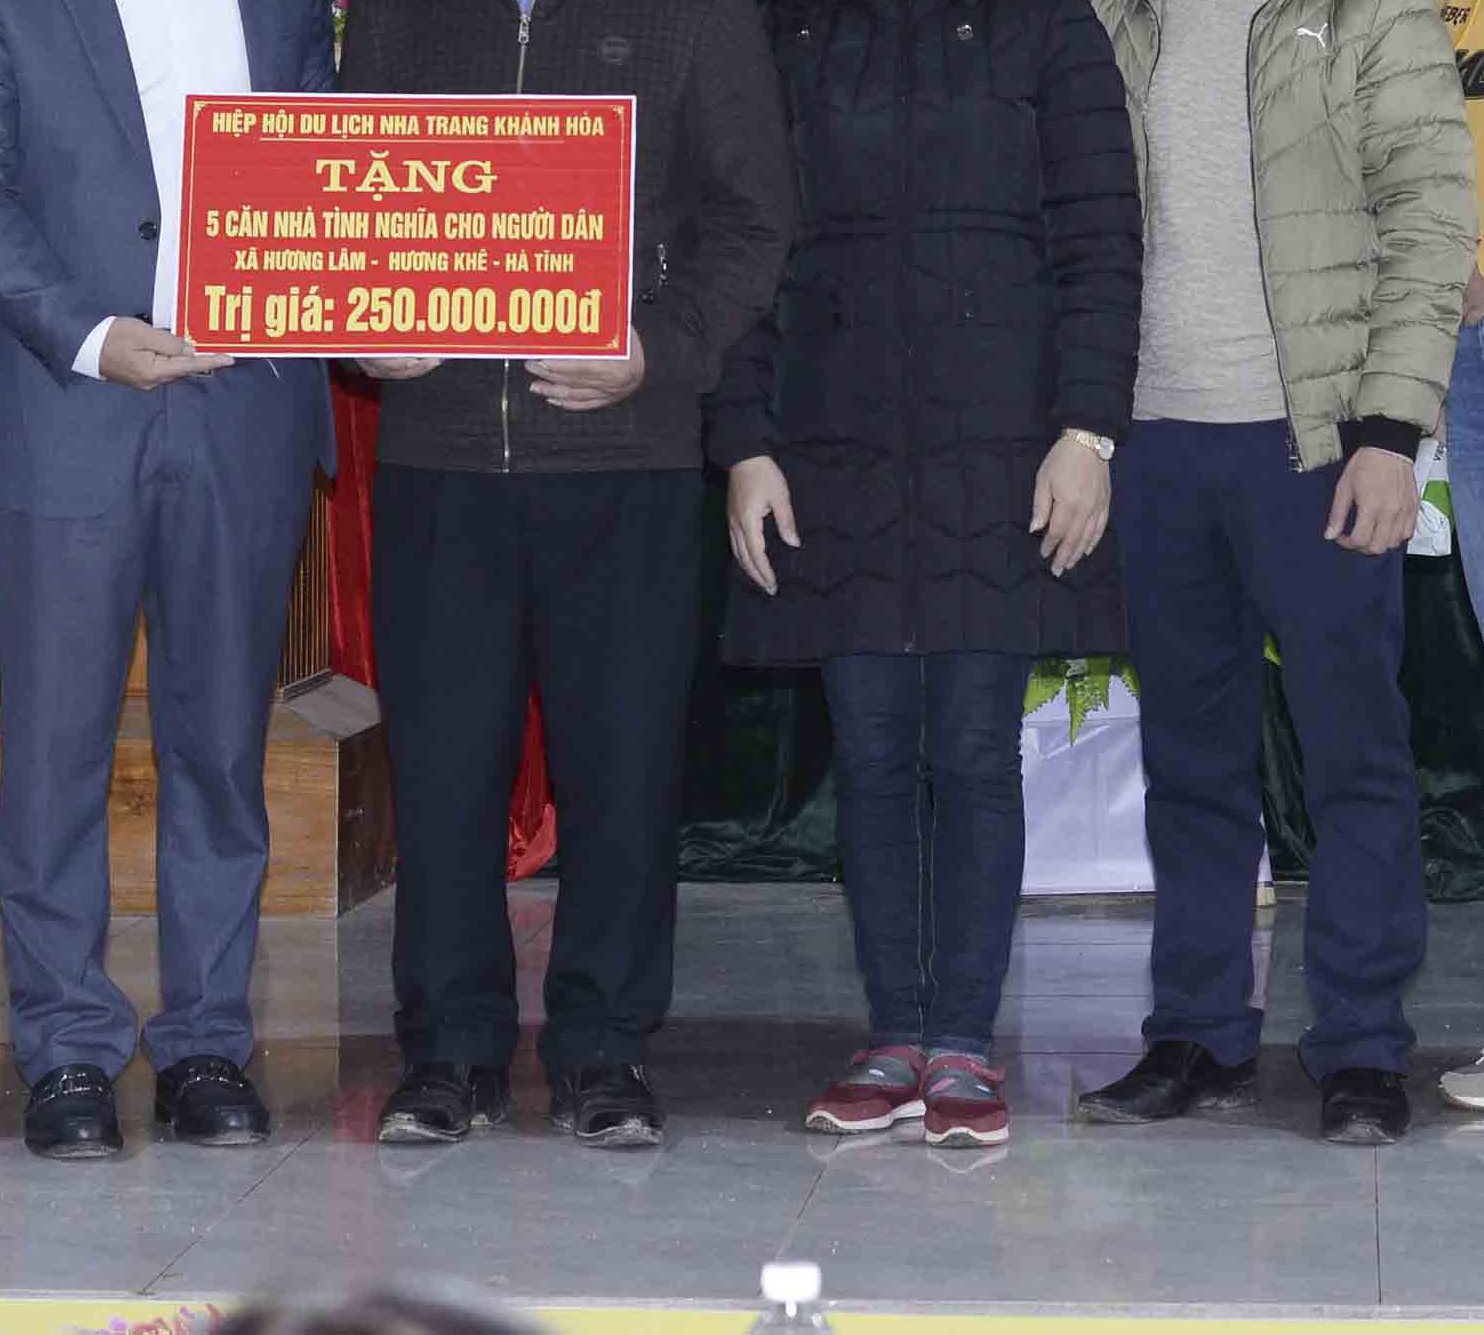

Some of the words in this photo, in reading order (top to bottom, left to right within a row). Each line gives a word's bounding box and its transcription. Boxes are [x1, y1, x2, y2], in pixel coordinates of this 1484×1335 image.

[212, 108, 257, 138] HIỆP
[262, 108, 295, 138] HỘI
[299, 113, 327, 135] DU
[330, 113, 374, 139] LỊCH
[379, 114, 420, 136] NHA
[425, 115, 489, 136] TRANG
[494, 111, 560, 137] KHÁNH
[566, 111, 605, 137] HÒA
[315, 149, 499, 202] TẶNG
[205, 209, 219, 238] 5
[224, 204, 269, 238] CĂN
[273, 205, 317, 239] NHÀ
[322, 205, 370, 239] TÌNH
[374, 206, 438, 240] NGHĨA
[444, 212, 486, 240] CHO
[491, 206, 555, 241] NGƯỜI
[560, 208, 604, 242] DÂN
[234, 246, 259, 271] XÃ
[263, 249, 324, 272] HƯƠNG
[328, 247, 366, 272] LÂM
[388, 249, 449, 272] HƯƠNG
[453, 248, 488, 272] KHÊ
[505, 248, 529, 273] HÀ
[533, 249, 574, 273] TĨNH
[204, 284, 253, 342] Trị
[264, 285, 335, 338] giá:
[345, 286, 602, 334] 250.000.000đ
